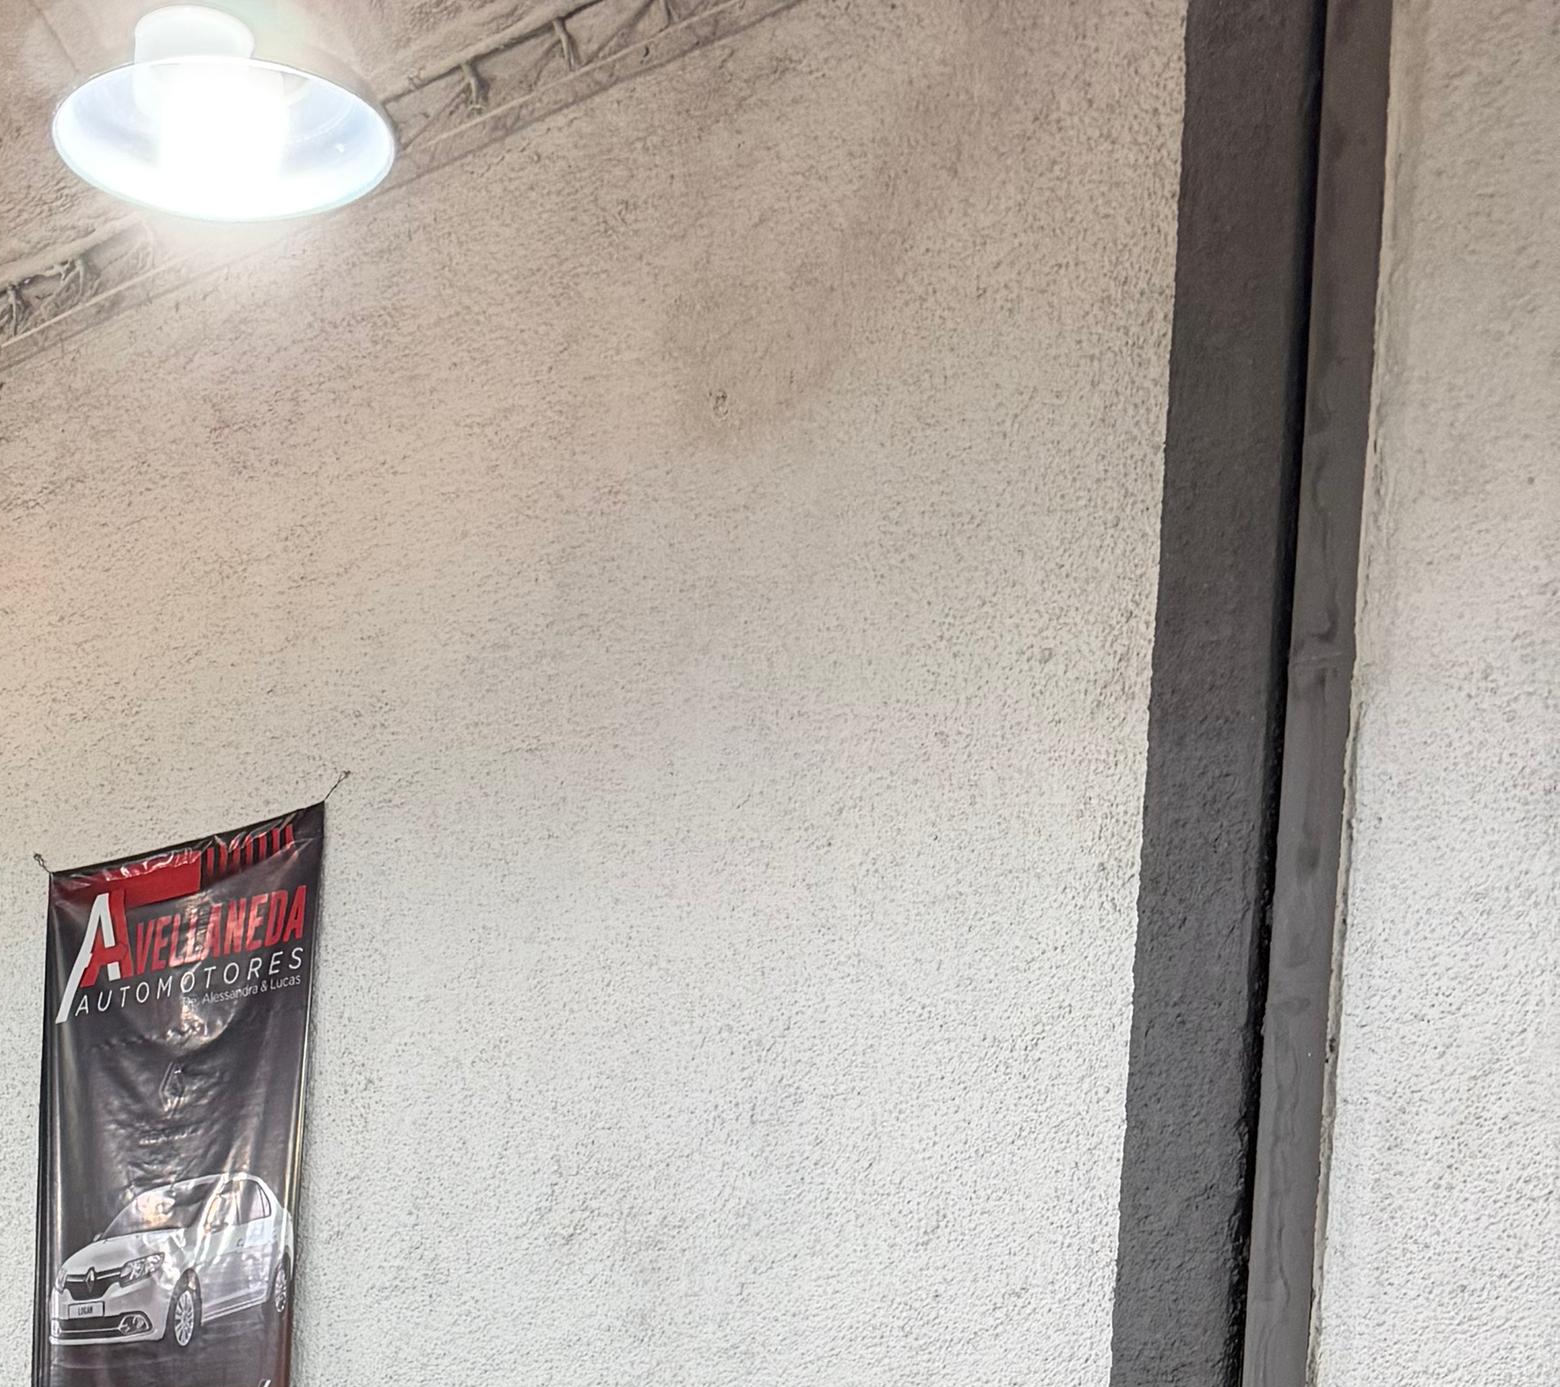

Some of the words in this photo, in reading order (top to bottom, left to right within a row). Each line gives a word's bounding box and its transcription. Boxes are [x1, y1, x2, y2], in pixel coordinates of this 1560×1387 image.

[74, 947, 304, 1017] AUTOMOTORES
[202, 984, 259, 1005] Alessandra
[260, 980, 268, 992] &
[270, 974, 301, 991] Lucas
